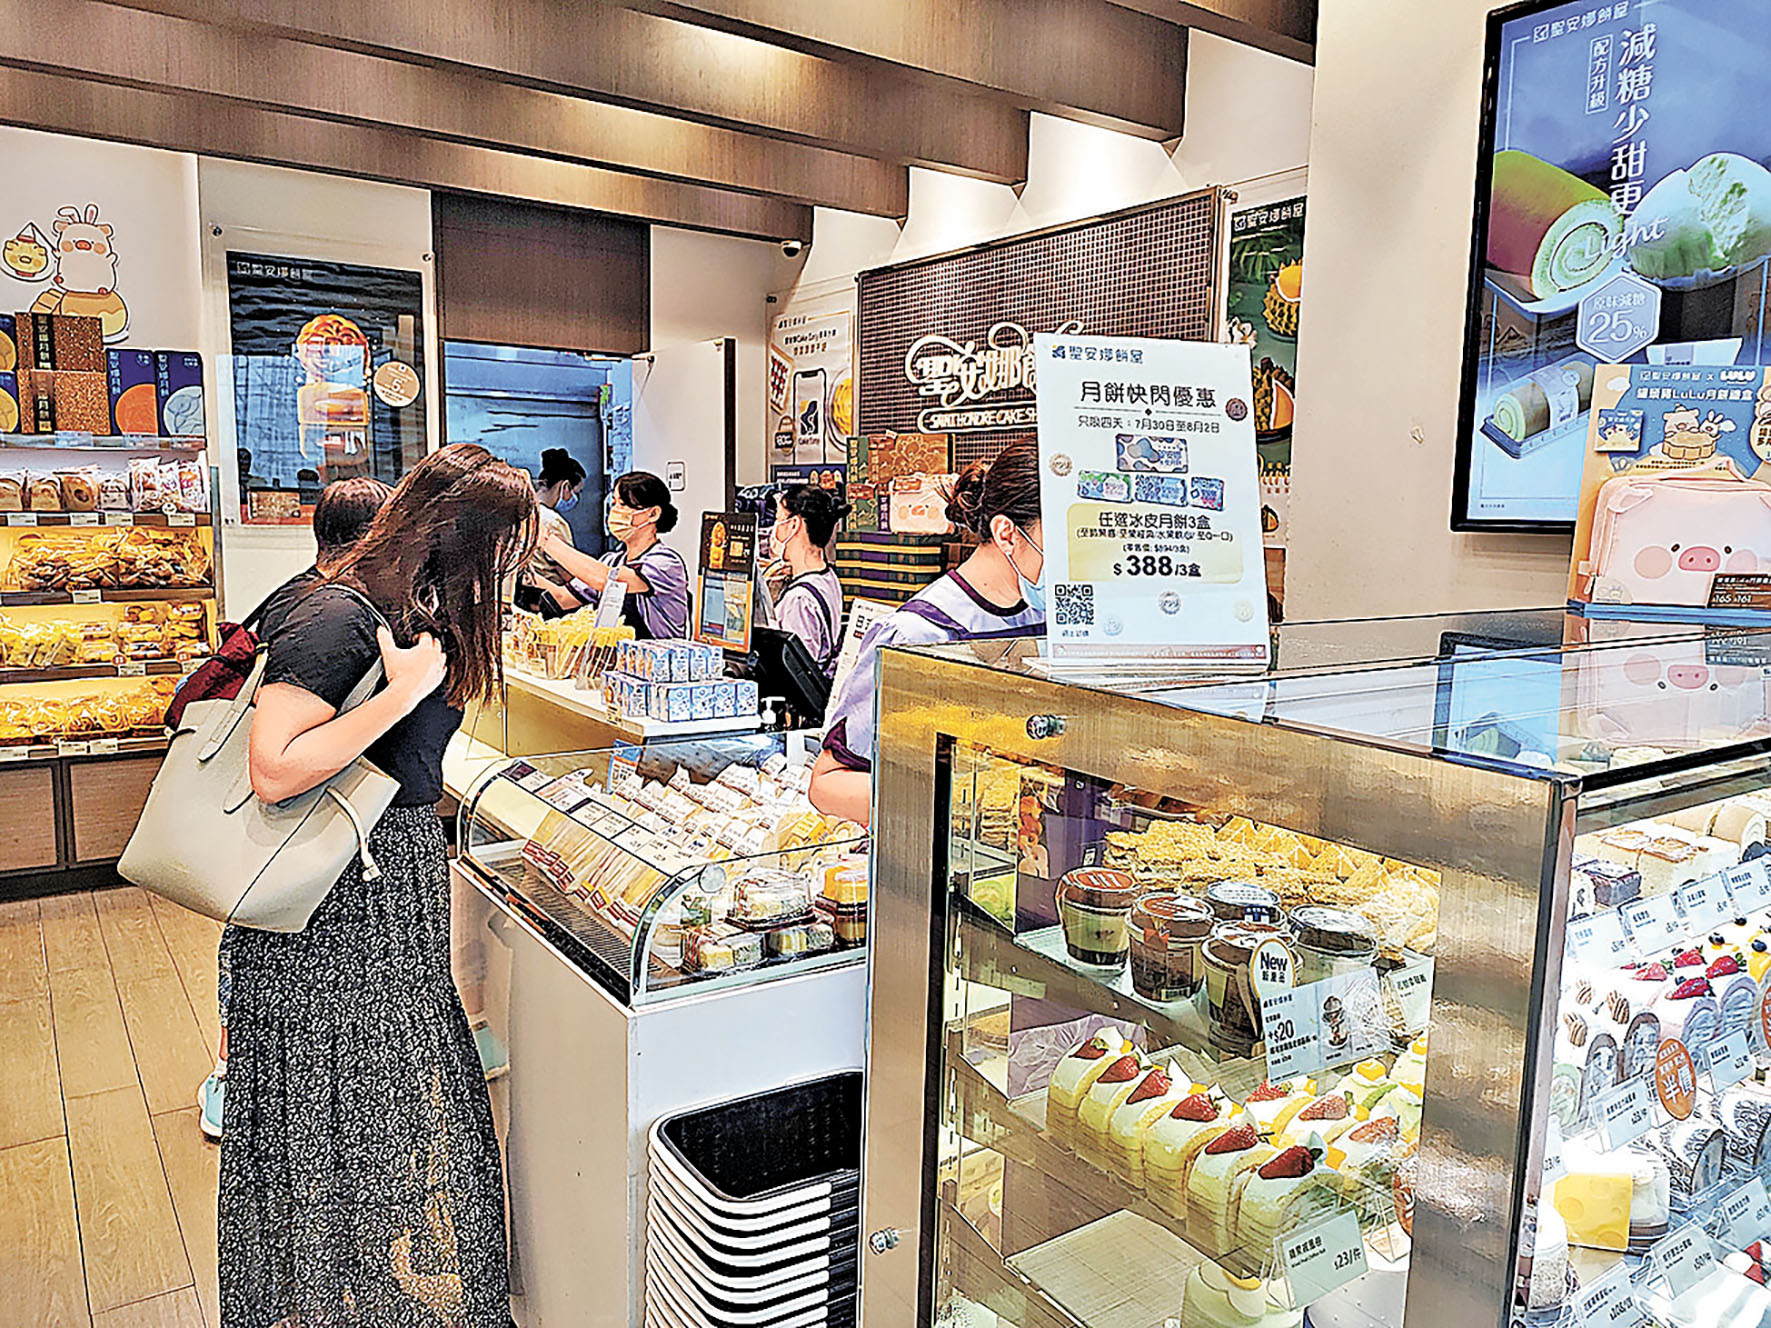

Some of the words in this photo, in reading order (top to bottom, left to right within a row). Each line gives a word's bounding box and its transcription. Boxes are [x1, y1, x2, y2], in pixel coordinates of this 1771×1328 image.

[1589, 40, 1611, 108] 配方升級
[1587, 309, 1648, 344] 25%
[1080, 381, 1217, 408] 月餅快閃優惠
[1098, 512, 1211, 530] 任選冰皮月餅3盒
[1260, 951, 1288, 971] New
